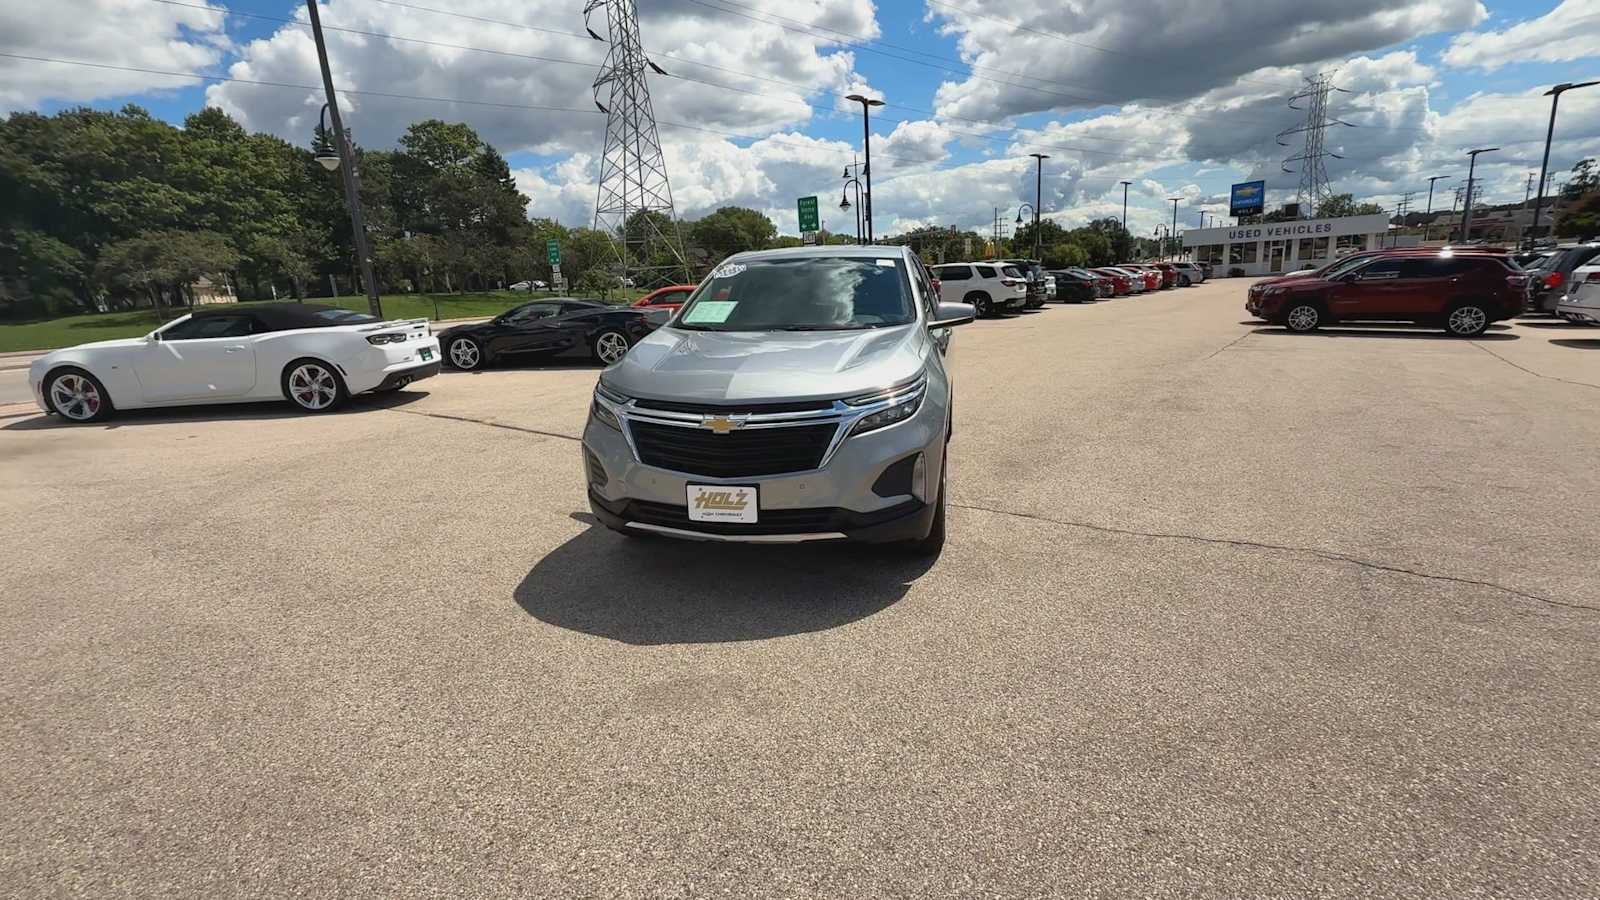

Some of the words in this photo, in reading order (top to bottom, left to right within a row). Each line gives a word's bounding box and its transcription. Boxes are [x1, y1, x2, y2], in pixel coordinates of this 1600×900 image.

[1229, 229, 1261, 240] USED
[1267, 223, 1332, 237] VEHICLES
[695, 491, 749, 511] HOLZ
